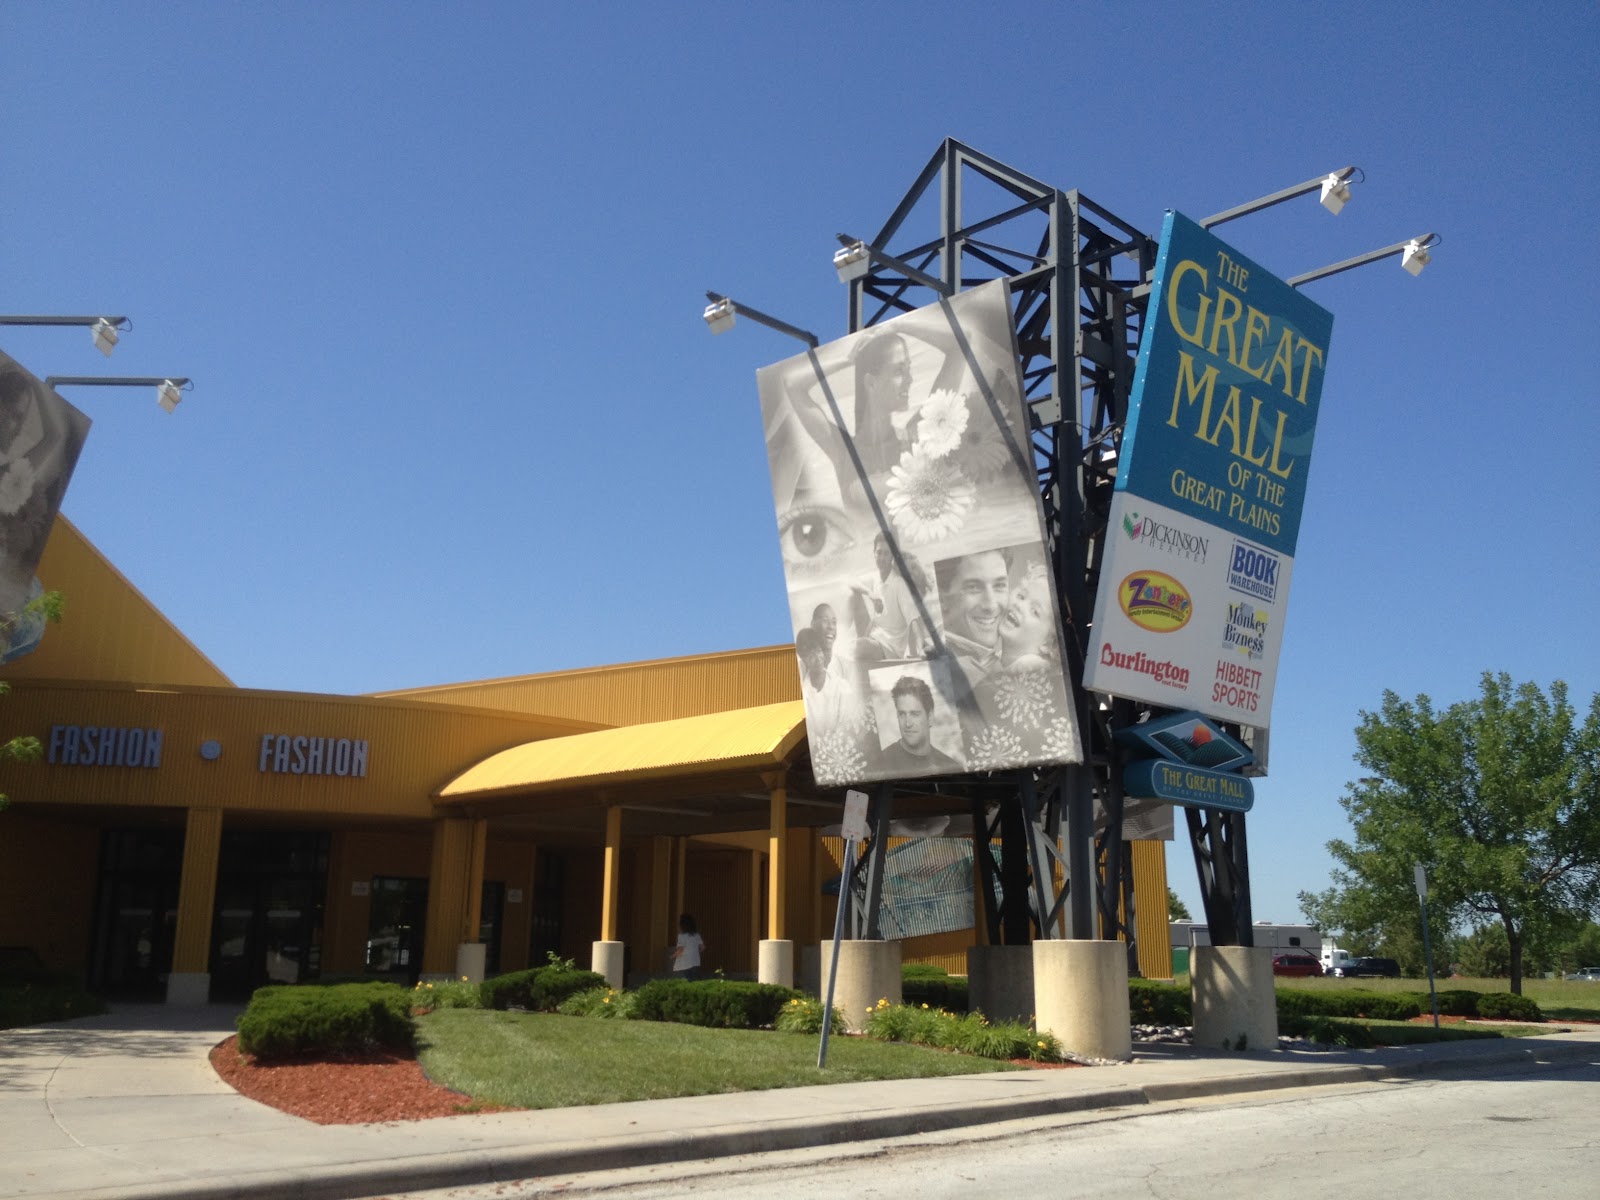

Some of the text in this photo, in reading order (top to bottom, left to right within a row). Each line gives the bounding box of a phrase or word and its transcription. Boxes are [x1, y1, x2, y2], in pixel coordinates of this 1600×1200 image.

[1217, 250, 1250, 292] THE
[1167, 259, 1324, 405] GREAT
[1166, 350, 1295, 480] MALL
[1171, 469, 1281, 536] GREAT PLAINS
[1228, 461, 1286, 508] OF THE
[1142, 517, 1209, 556] DICKINSON
[1232, 545, 1278, 585] BOOK
[1231, 573, 1274, 599] WAREHOUSE
[1224, 623, 1264, 653] Bizness
[1226, 603, 1268, 638] Monkey
[1100, 642, 1190, 684] Burlington
[1216, 660, 1262, 690] HIBBETT
[1212, 682, 1258, 712] SPORTS
[49, 725, 163, 768] FASHION
[260, 734, 368, 777] FASHION
[1162, 767, 1245, 799] THE GREAT MALL
